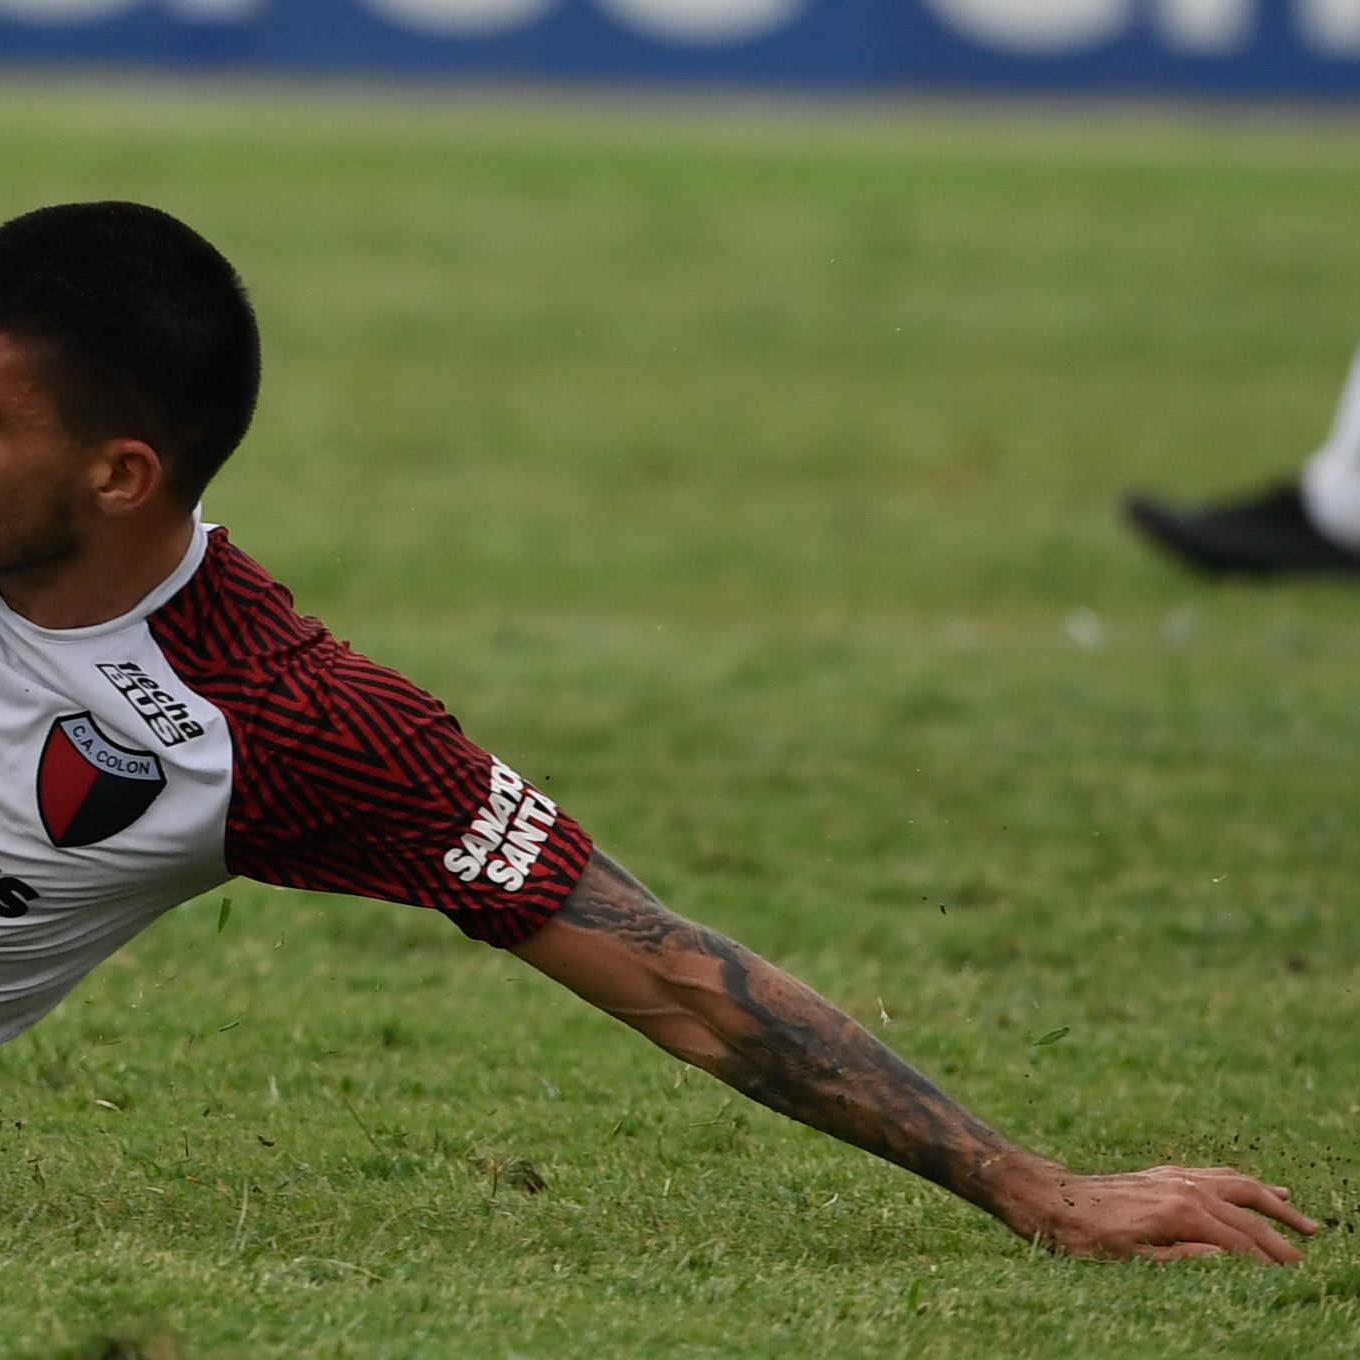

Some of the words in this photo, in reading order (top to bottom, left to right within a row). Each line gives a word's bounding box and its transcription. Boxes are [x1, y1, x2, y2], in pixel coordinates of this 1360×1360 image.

[97, 663, 185, 747] BUS
[72, 724, 94, 756] C.A.
[95, 749, 151, 776] COLON
